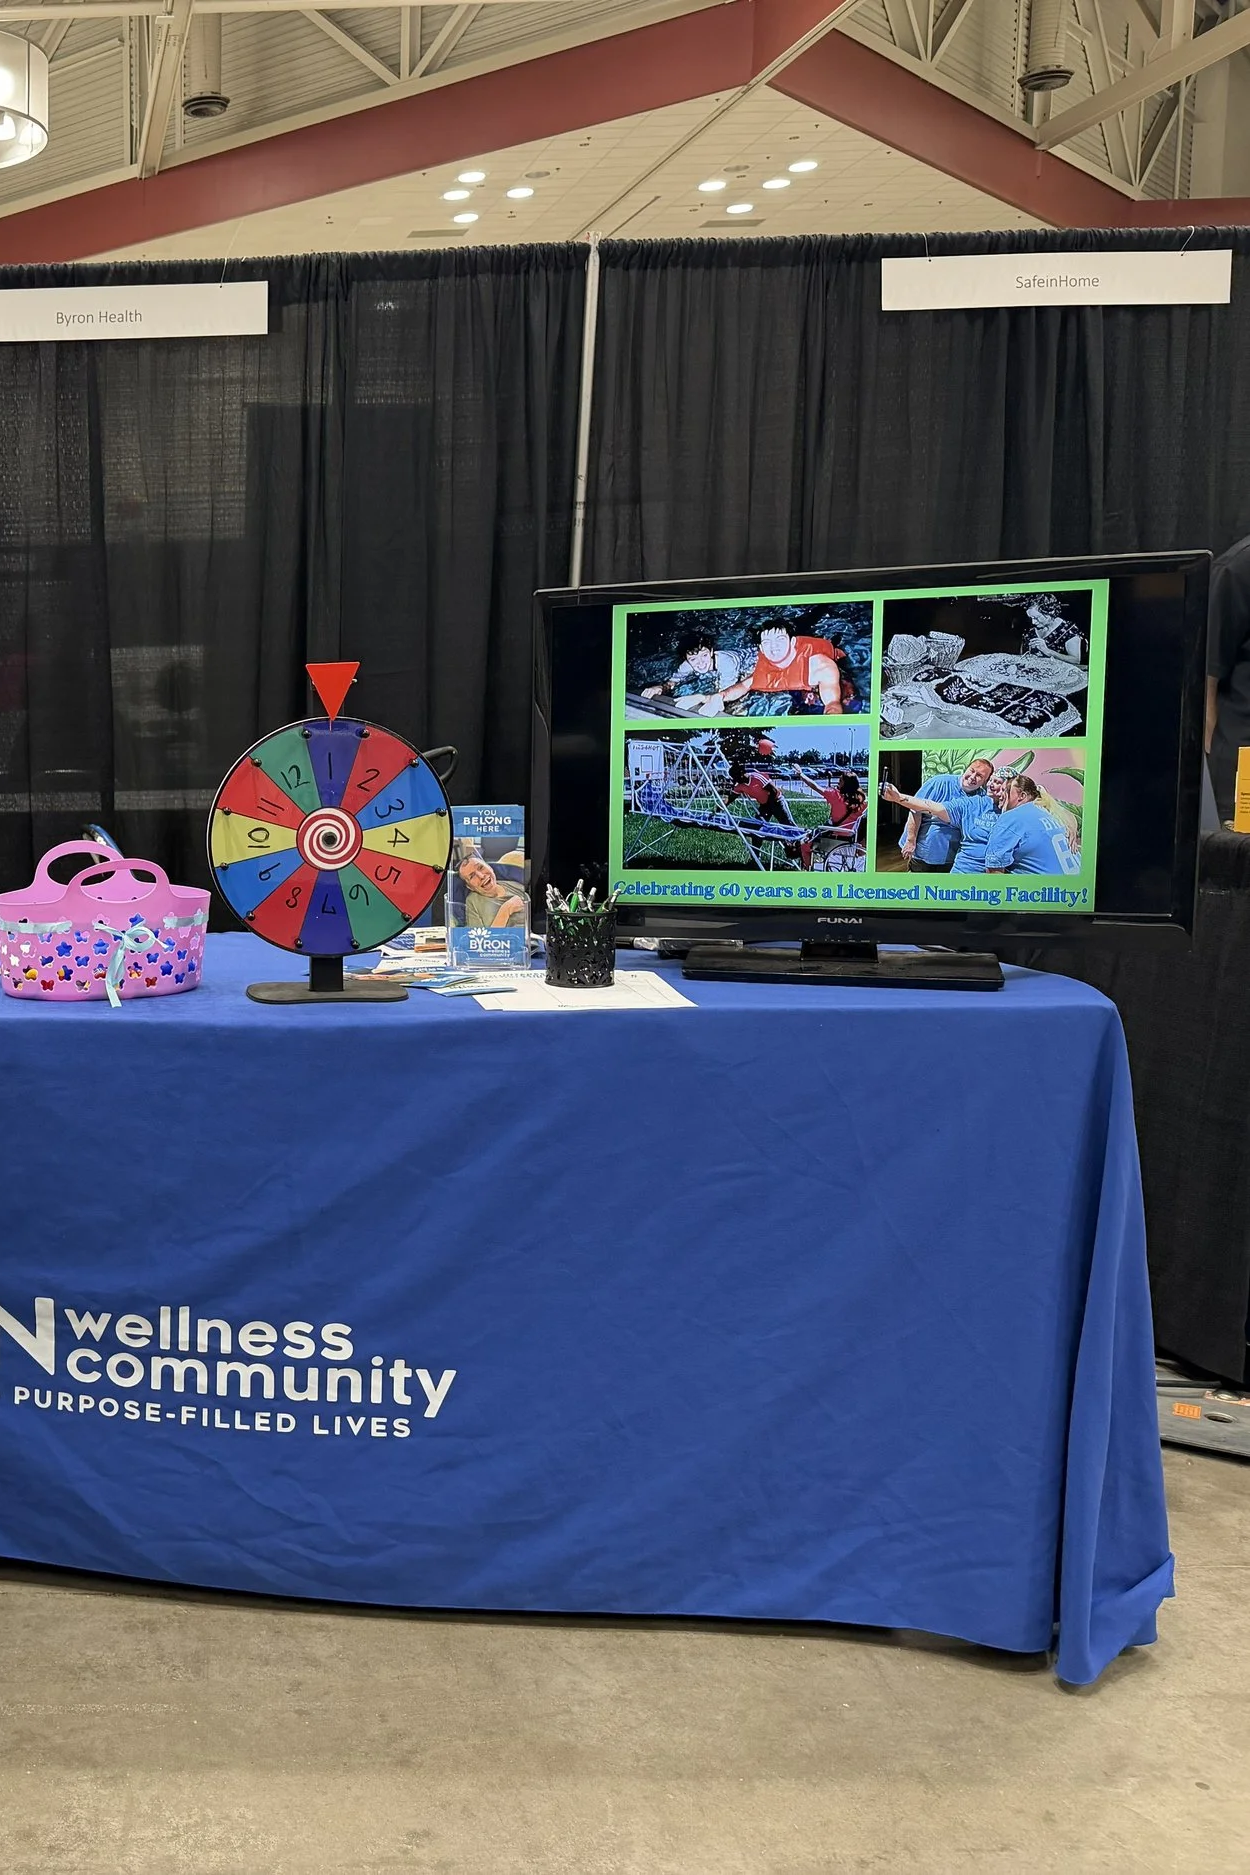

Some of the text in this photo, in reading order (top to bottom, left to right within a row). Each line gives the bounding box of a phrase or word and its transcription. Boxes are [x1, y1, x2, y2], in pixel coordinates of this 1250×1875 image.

[1015, 274, 1100, 289] SafeinHome
[55, 309, 142, 327] Byron Health
[279, 764, 311, 790] 12
[327, 751, 334, 781] 1
[356, 767, 381, 793] 2
[256, 797, 285, 817] 11
[374, 797, 405, 819] 3
[477, 809, 497, 817] YOU
[463, 816, 512, 825] BELONG
[476, 825, 500, 833] HERE
[247, 826, 271, 849] 10
[387, 827, 411, 848] 4
[374, 864, 402, 885] 5
[285, 886, 303, 909] 8
[321, 893, 337, 915] 7
[349, 883, 370, 906] 6
[613, 881, 1089, 908] Celebrating 60 years as a Licensed Nursing Facility!
[469, 937, 511, 950] BYRON
[64, 1305, 355, 1361] wellness
[65, 1347, 457, 1419] community
[13, 1384, 297, 1434] PURPOSE-FILLED
[313, 1414, 412, 1438] LIVES
